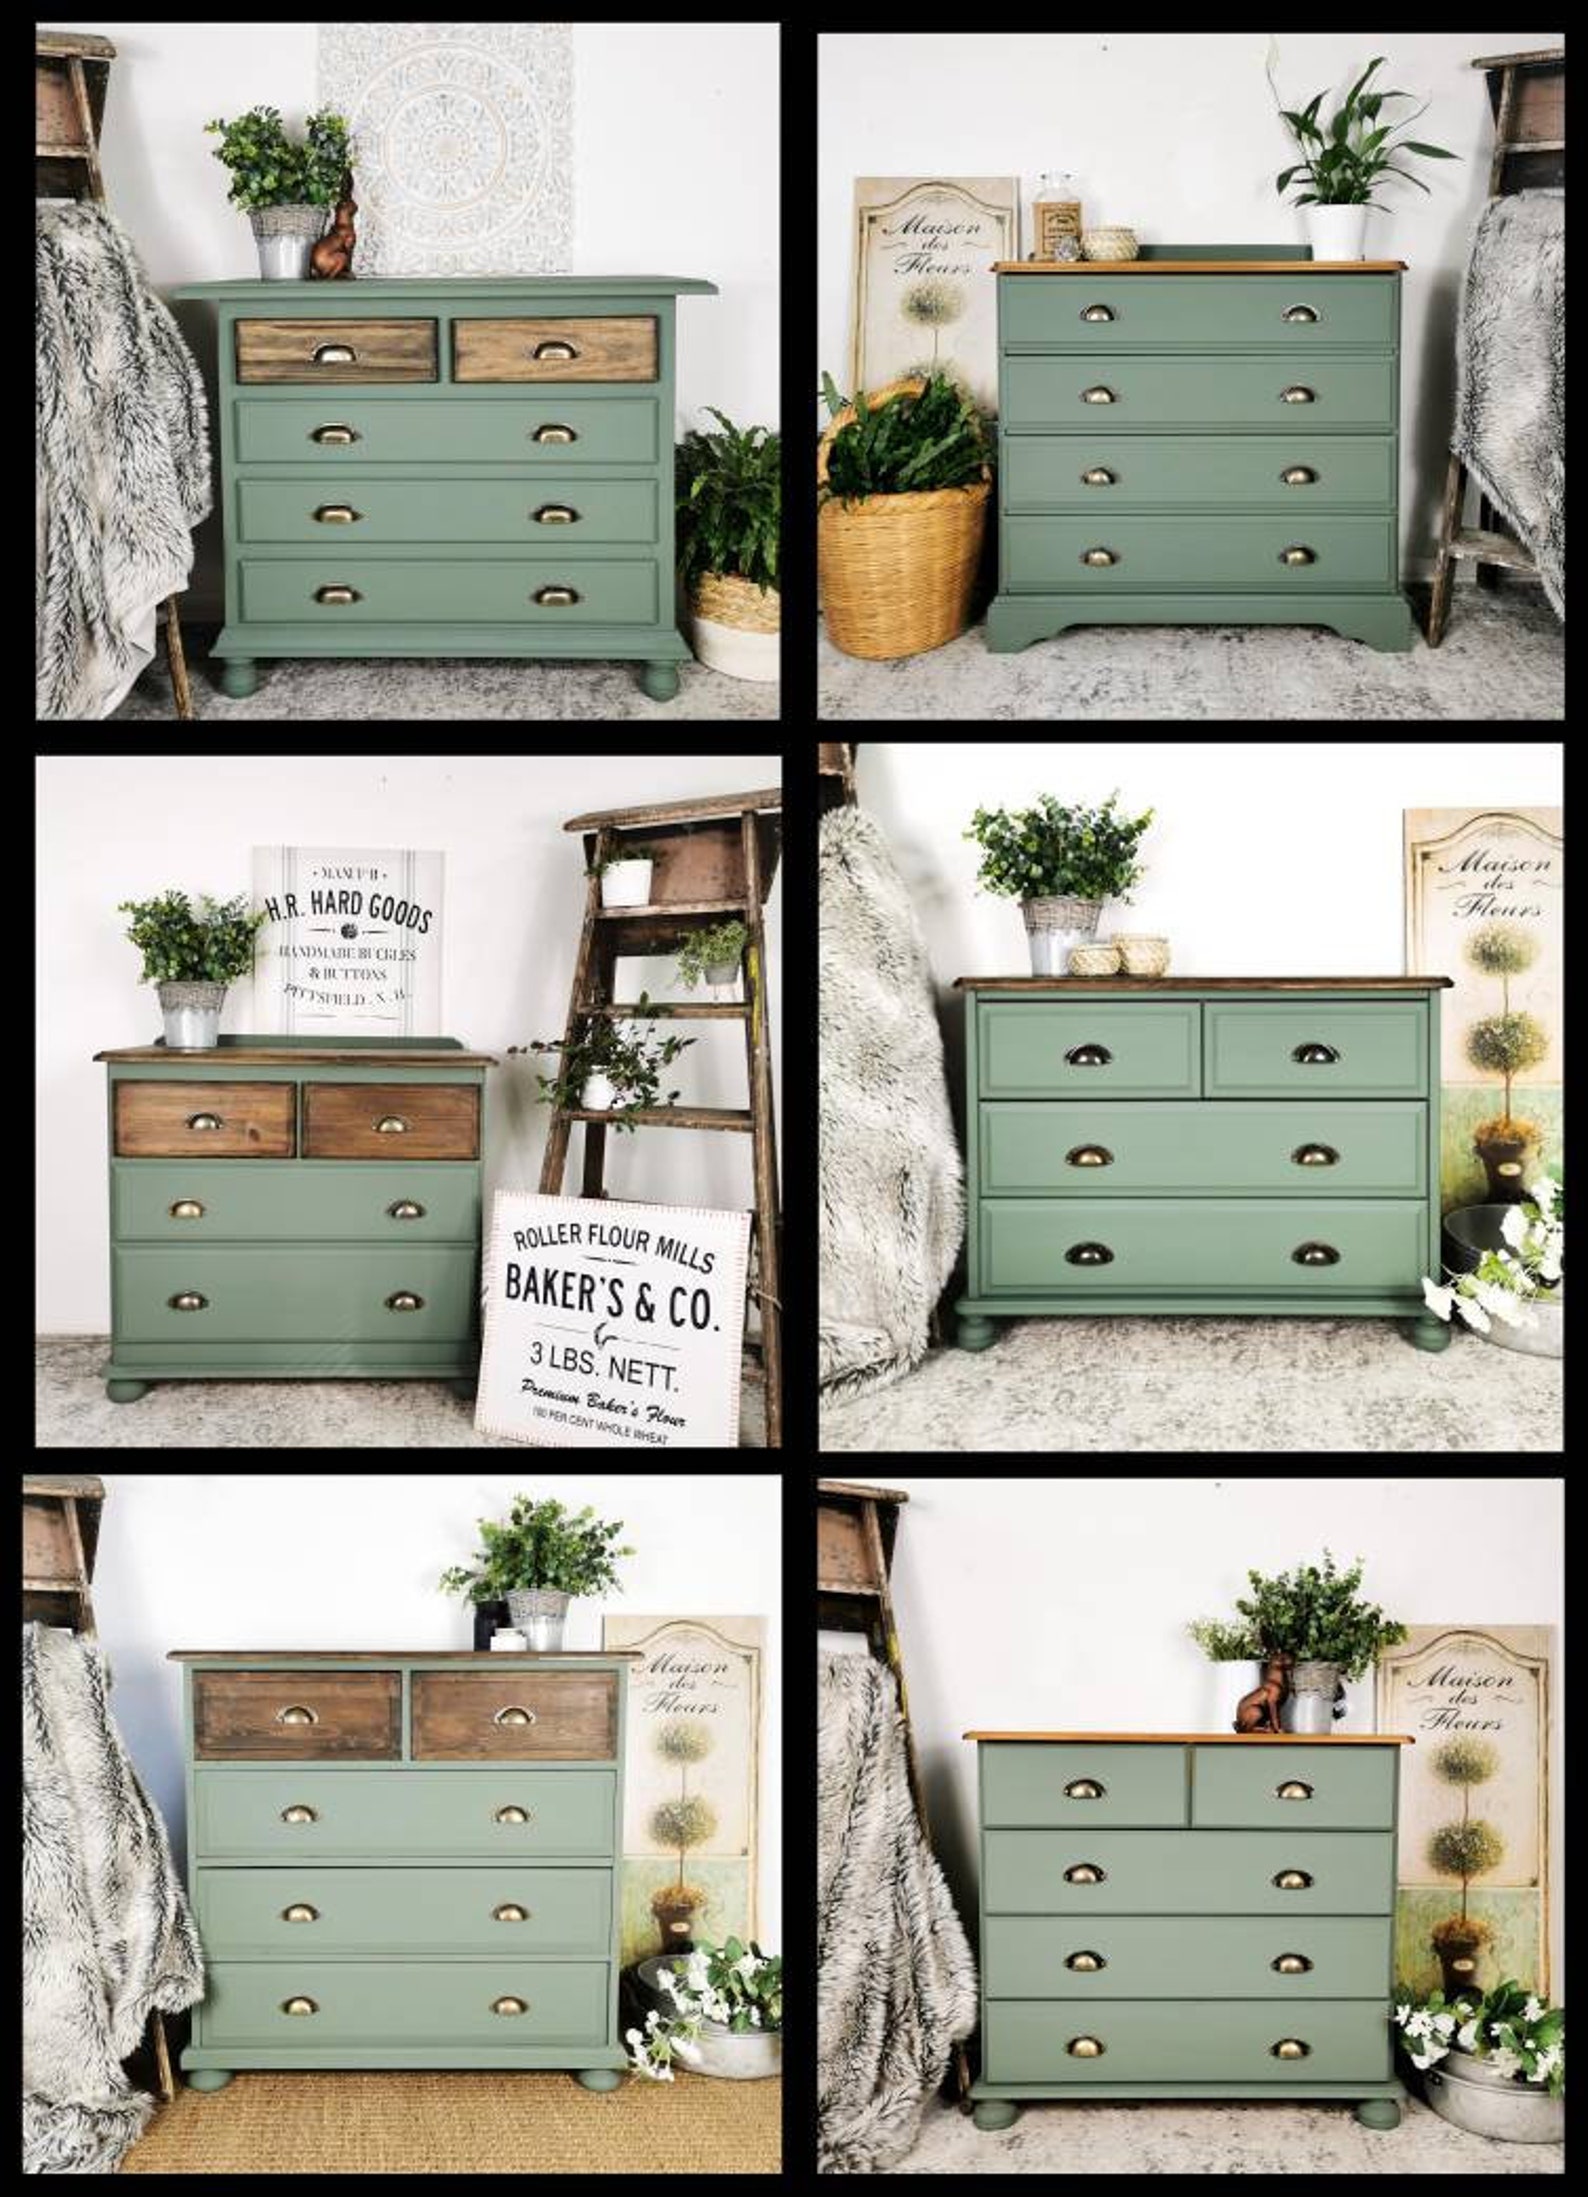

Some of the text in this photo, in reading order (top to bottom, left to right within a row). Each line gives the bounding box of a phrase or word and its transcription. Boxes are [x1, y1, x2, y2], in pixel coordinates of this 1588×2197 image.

[882, 214, 981, 235] Maison
[922, 234, 949, 251] des
[1437, 850, 1551, 873] Maison
[1483, 873, 1515, 890] des
[265, 890, 433, 934] H.R. HARD GOODS
[1452, 892, 1542, 918] Fleurs
[513, 1222, 716, 1275] ROLLER FLOUR MILLS
[505, 1262, 721, 1333] BAKER'S & CO.
[530, 1341, 680, 1394] 3 LBS. NETT.
[521, 1377, 687, 1428] Premium Baker's Flour
[550, 1410, 568, 1424] PER
[568, 1414, 595, 1429] CENT
[595, 1419, 631, 1437] WHOLE
[633, 1428, 669, 1445] WHEAT
[631, 1651, 728, 1675] Maison
[668, 1676, 697, 1691] des
[1407, 1665, 1512, 1687] Maison
[642, 1691, 718, 1714] Fleurs
[1448, 1689, 1478, 1705] des
[1420, 1708, 1502, 1731] Fleurs
